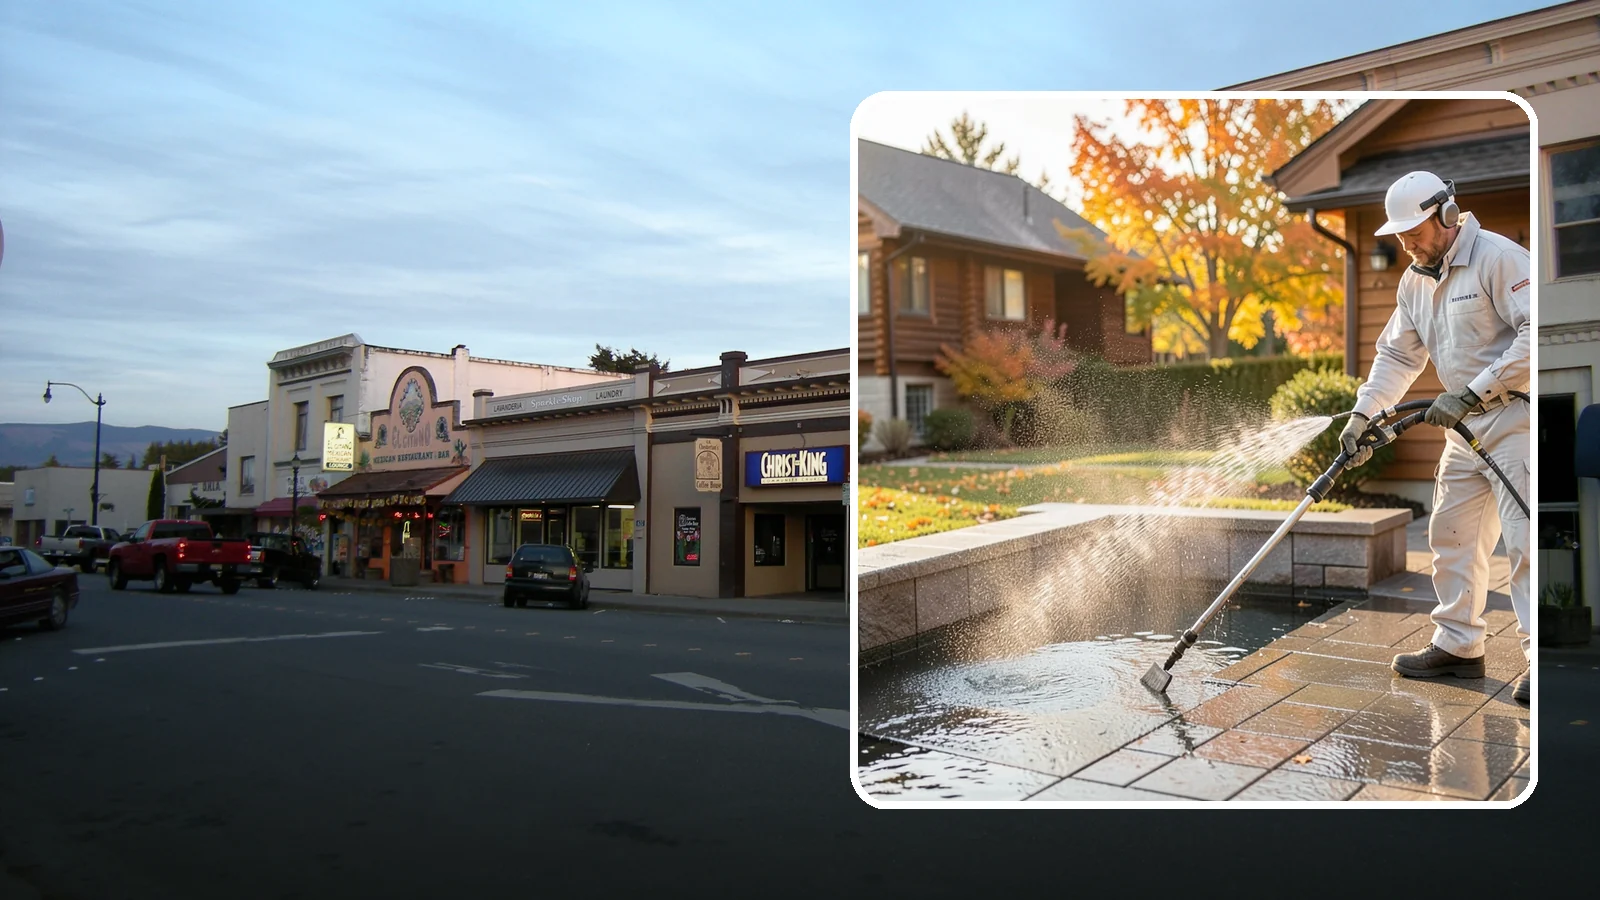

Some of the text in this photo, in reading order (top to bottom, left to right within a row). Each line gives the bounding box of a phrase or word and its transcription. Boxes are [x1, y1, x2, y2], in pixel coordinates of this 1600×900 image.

[595, 389, 623, 399] LAUNDRY
[562, 395, 582, 404] Shop
[493, 402, 522, 412] LAVANDERIA
[373, 455, 396, 464] MEXICAN
[397, 451, 433, 461] RESTAURANT
[438, 450, 450, 459] BAR
[761, 450, 827, 477] CHRIST KING
